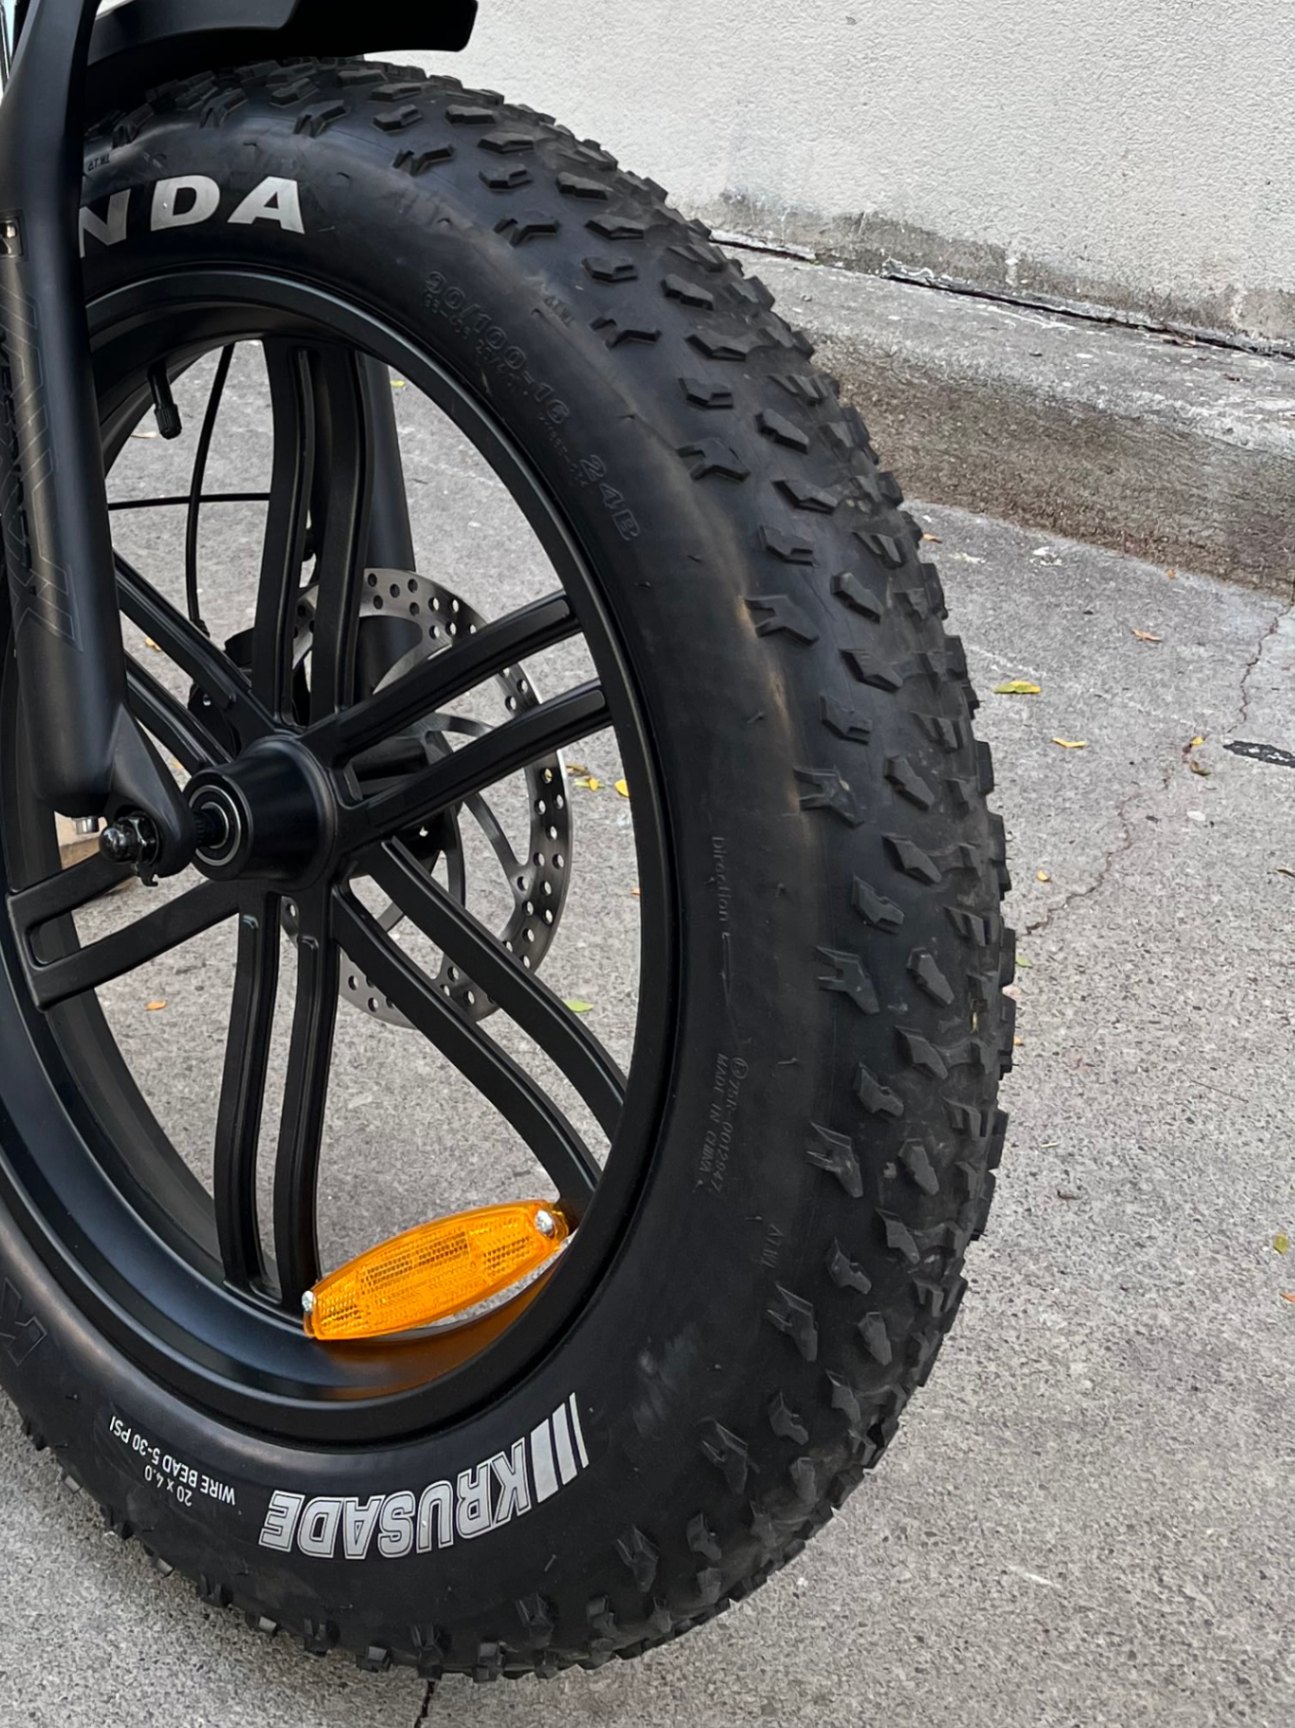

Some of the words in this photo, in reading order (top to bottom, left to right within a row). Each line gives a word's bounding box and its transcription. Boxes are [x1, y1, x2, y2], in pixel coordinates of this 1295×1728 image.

[711, 836, 730, 922] Direction
[713, 1053, 729, 1094] MADE
[709, 1103, 723, 1124] IN
[698, 1129, 717, 1174] CHINA
[109, 1415, 132, 1443] PSI
[132, 1433, 161, 1465] 5-30
[144, 1465, 165, 1488] 4.0
[162, 1454, 198, 1488] BEAD
[176, 1485, 193, 1507] 20
[200, 1475, 236, 1506] WIRE
[258, 1437, 532, 1560] KRUSADE
